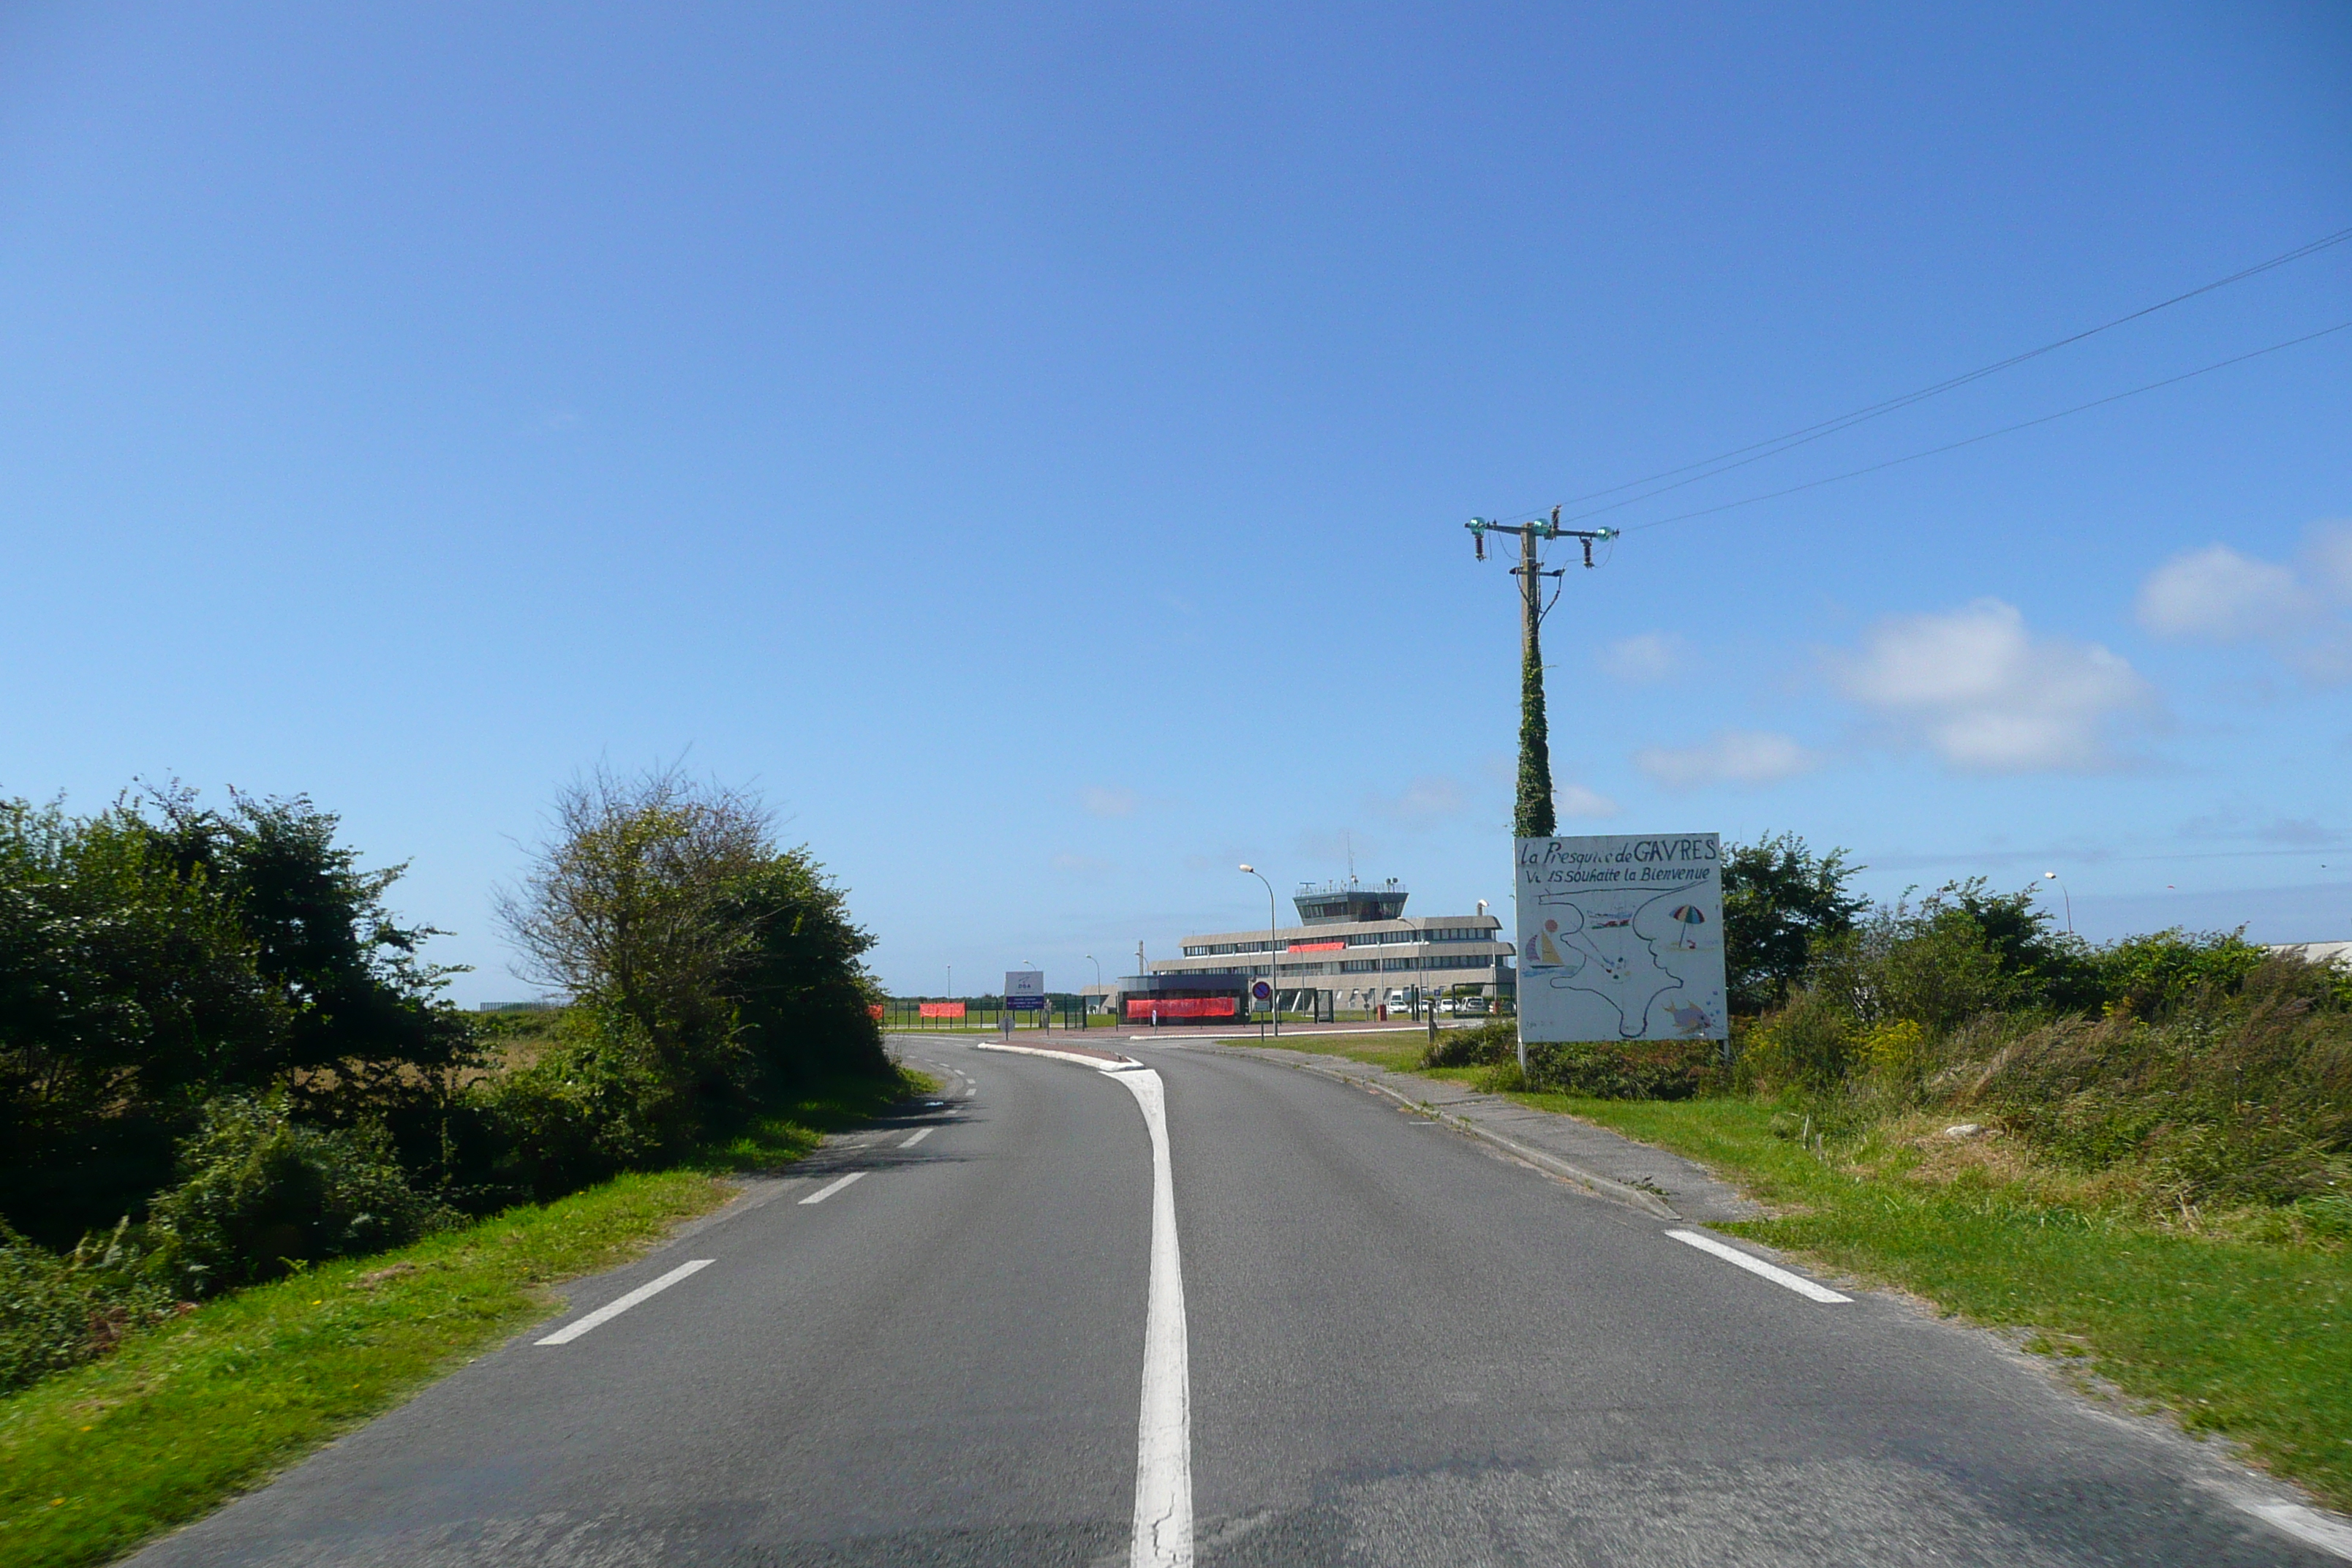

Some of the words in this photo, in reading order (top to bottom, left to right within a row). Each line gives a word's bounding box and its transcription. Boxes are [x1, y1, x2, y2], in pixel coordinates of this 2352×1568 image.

[1521, 843, 1538, 864] La
[1615, 843, 1632, 863] de
[1634, 839, 1716, 862] GAVRES
[1624, 867, 1637, 881] la
[1639, 867, 1710, 881] Bienvenue
